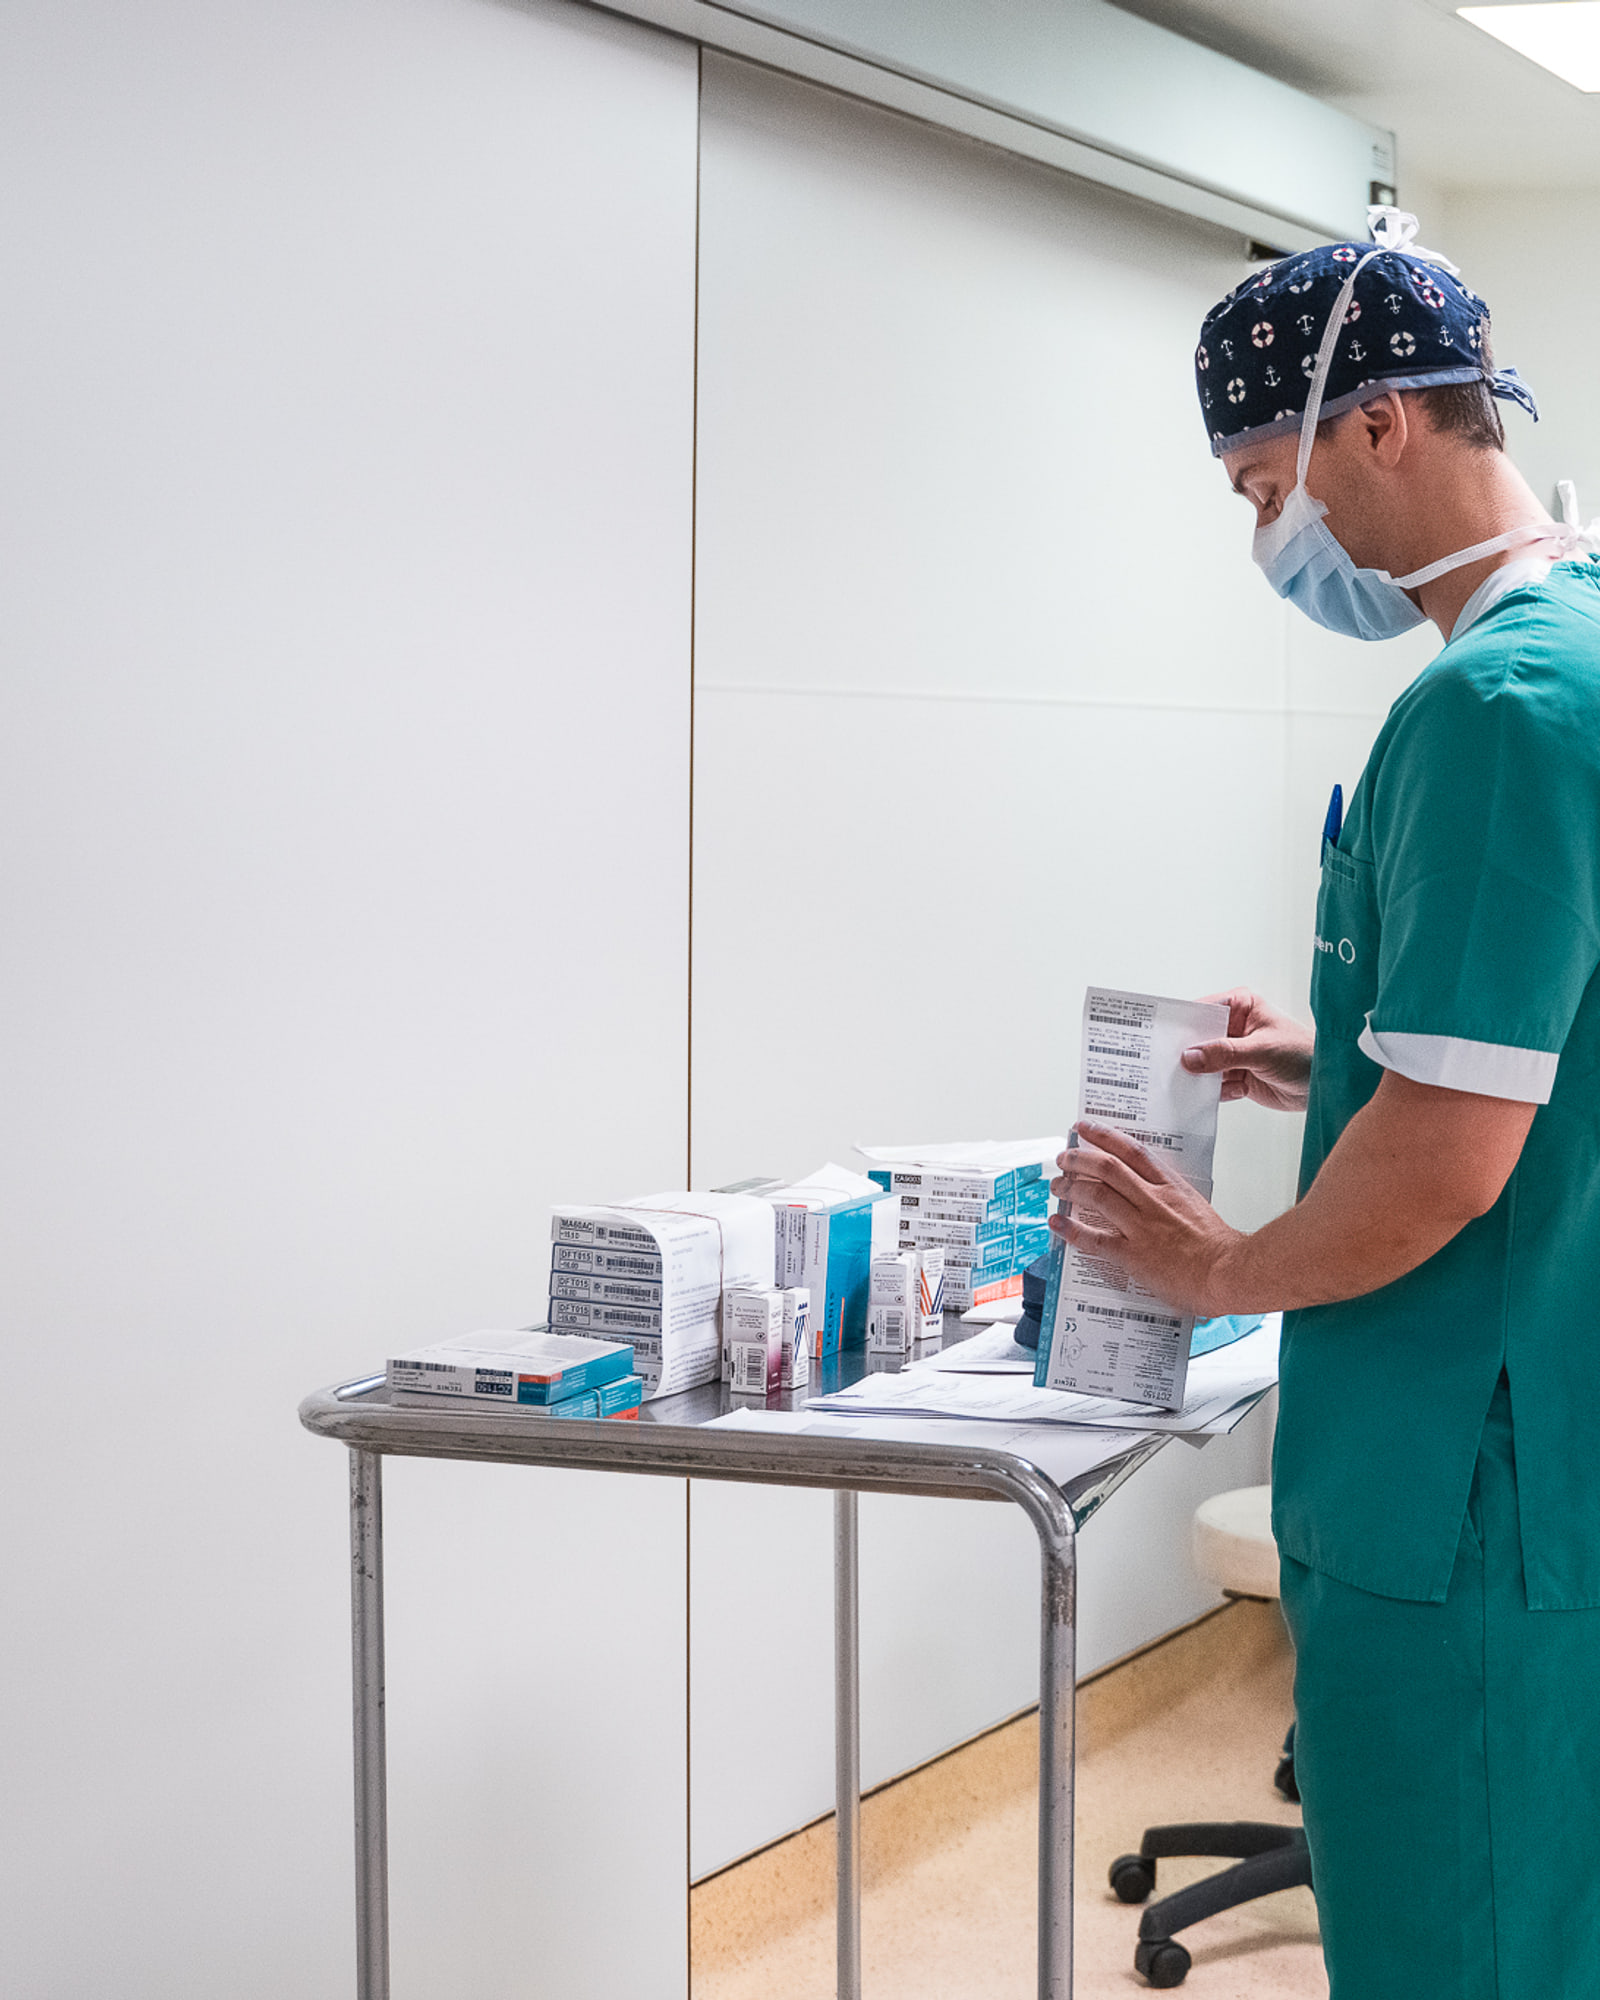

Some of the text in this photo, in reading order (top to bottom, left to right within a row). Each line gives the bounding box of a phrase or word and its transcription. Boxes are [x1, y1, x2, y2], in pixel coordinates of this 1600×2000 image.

[561, 1250, 592, 1261] DFT015
[559, 1276, 589, 1288] DFT015
[559, 1303, 589, 1314] DFT015
[477, 1382, 512, 1394] ZCT150
[1143, 1390, 1173, 1401] ZCT150
